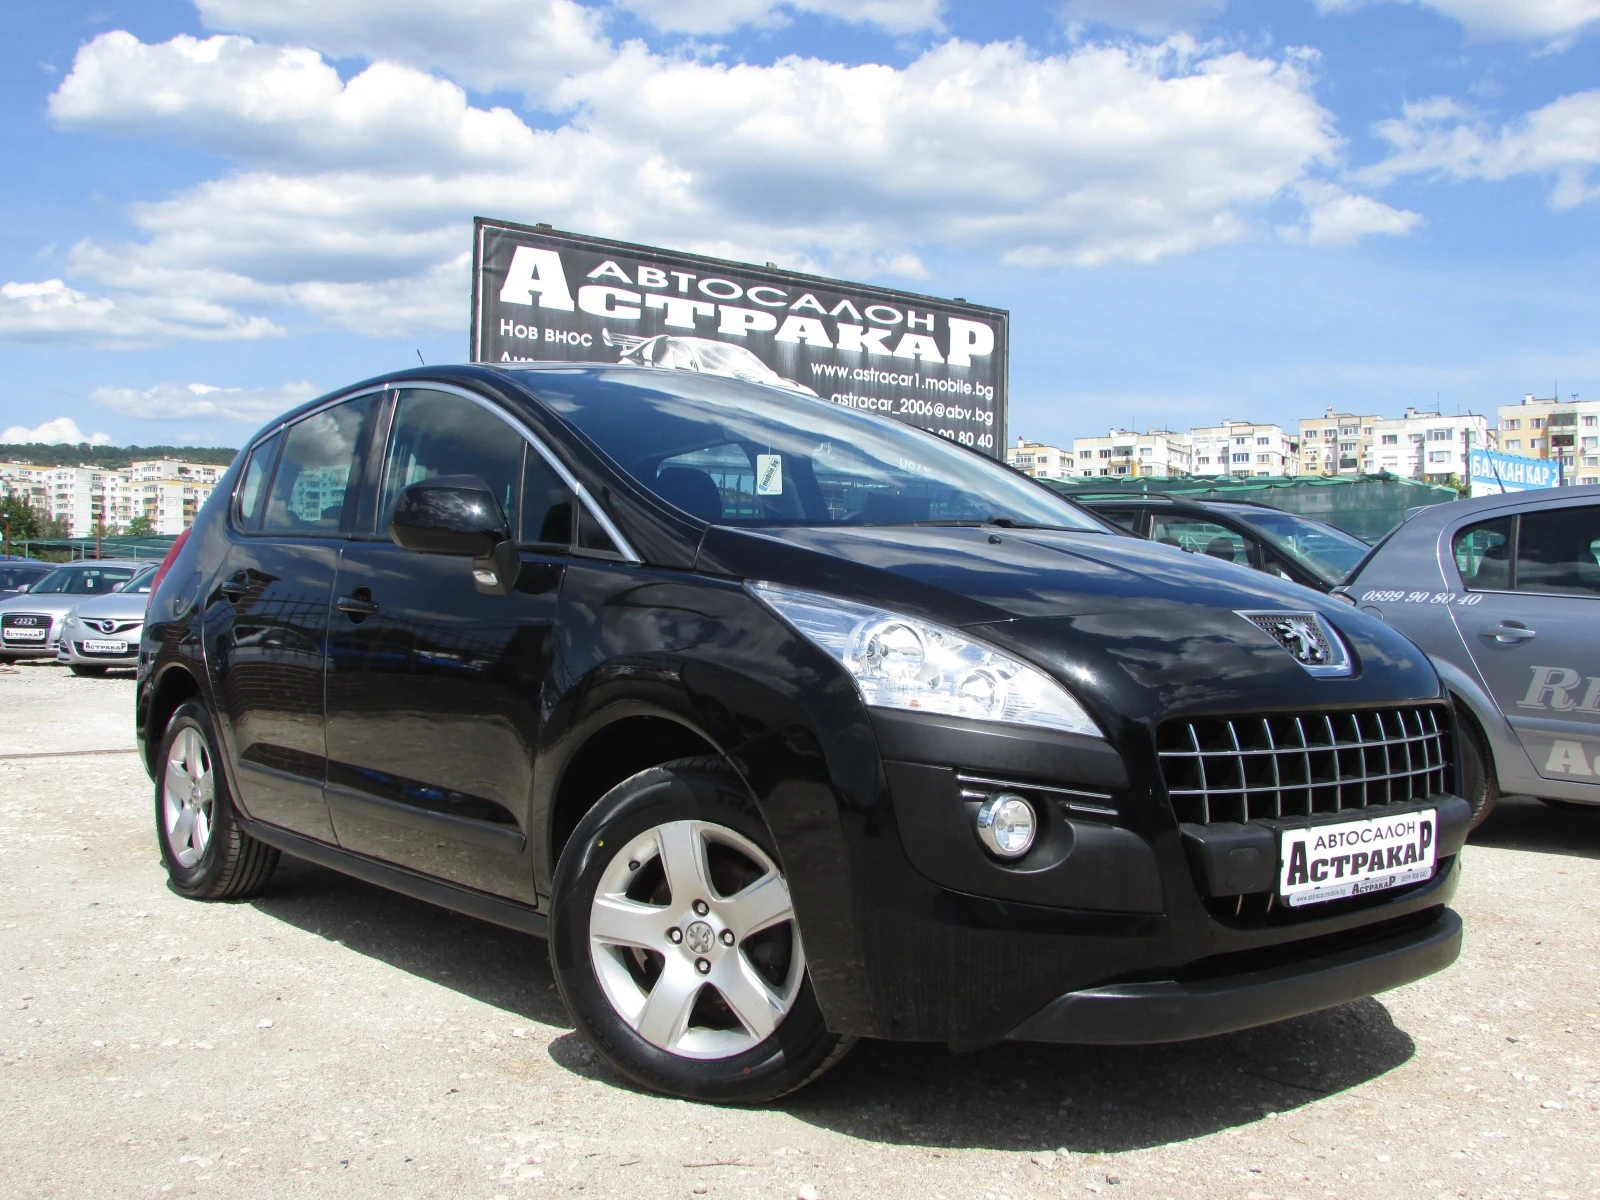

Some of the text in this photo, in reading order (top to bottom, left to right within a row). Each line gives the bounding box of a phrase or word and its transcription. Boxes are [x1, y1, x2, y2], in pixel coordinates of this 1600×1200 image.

[587, 260, 935, 331] АВТОСАЛОН
[811, 363, 994, 400] www.astracar1.mobile.bg
[831, 392, 993, 425] astracar_2006@abv.bg
[958, 431, 974, 446] 80
[977, 434, 993, 448] 40
[1472, 456, 1525, 480] БАЛКАН
[1526, 464, 1550, 485] КАР
[1362, 590, 1483, 606] 0899 90 80 40
[1314, 821, 1415, 850] АВТОСАЛОН
